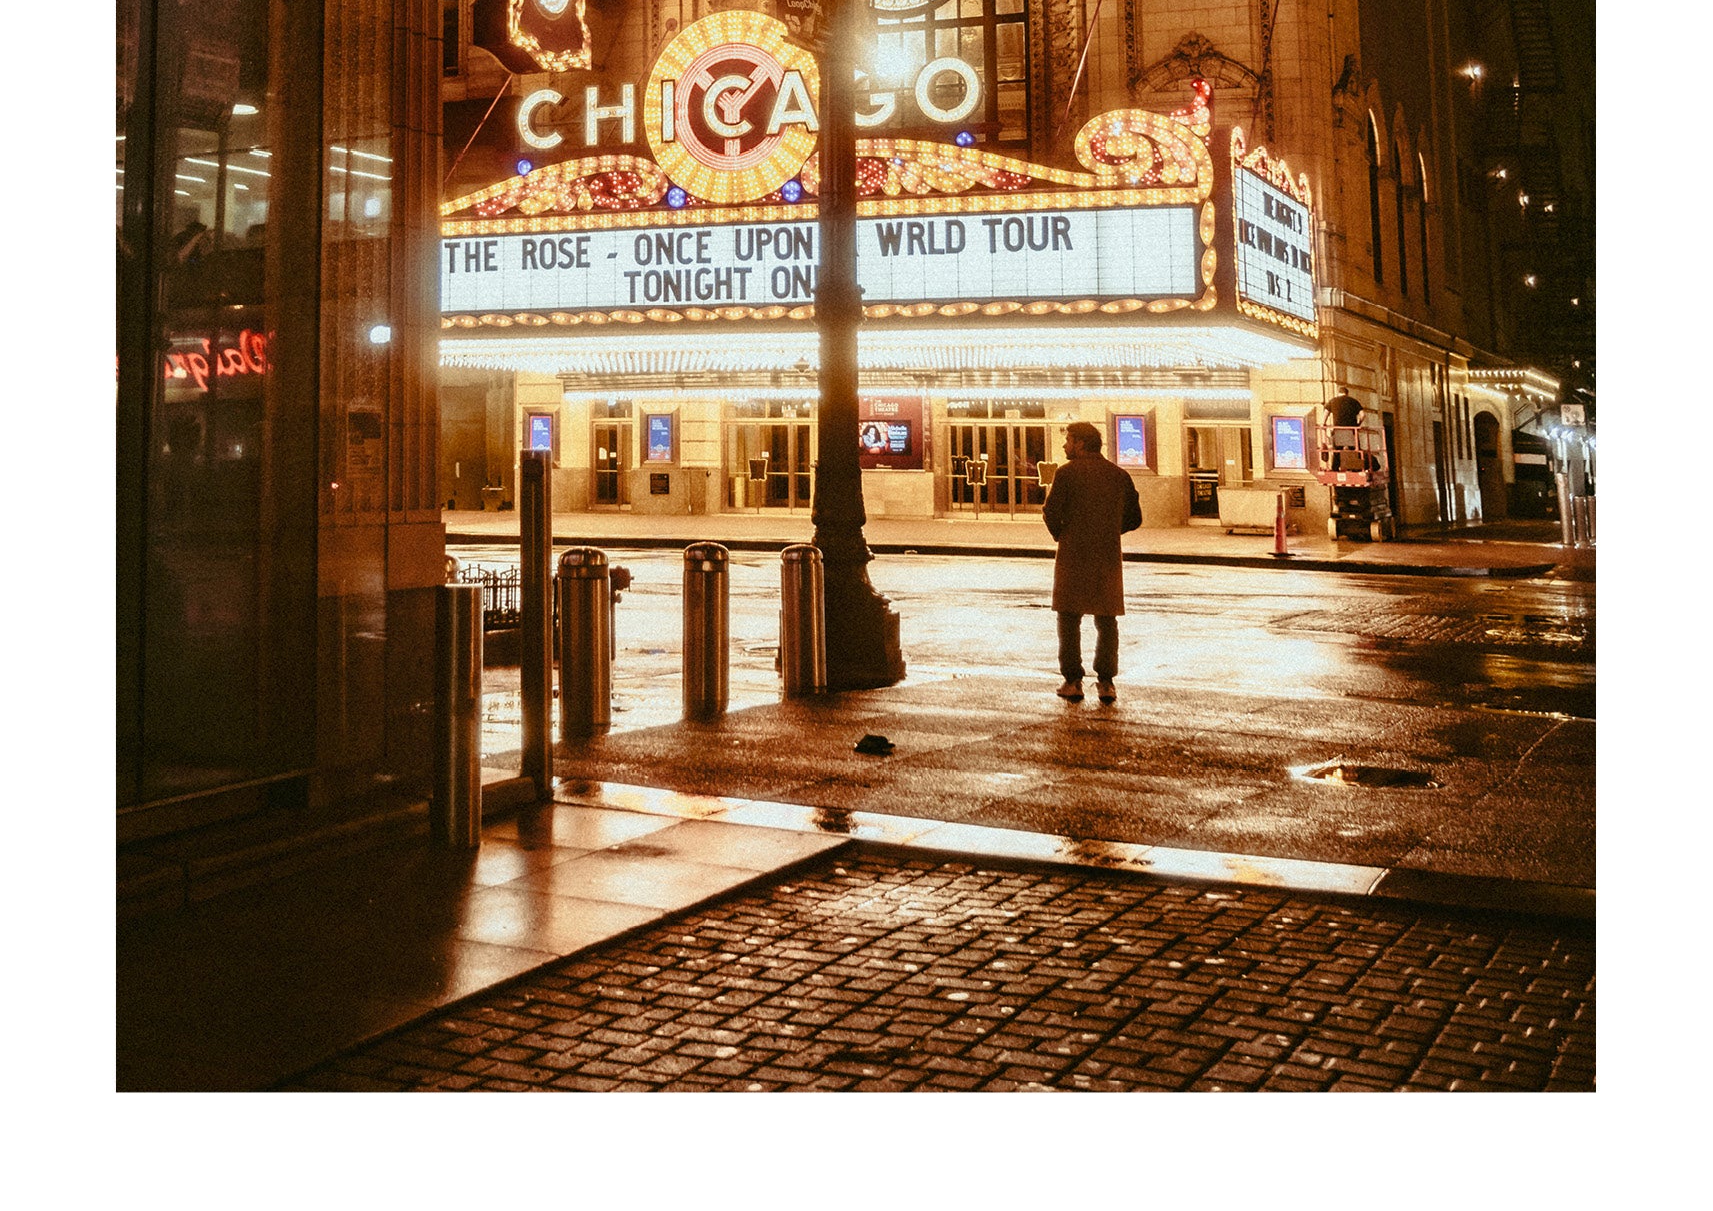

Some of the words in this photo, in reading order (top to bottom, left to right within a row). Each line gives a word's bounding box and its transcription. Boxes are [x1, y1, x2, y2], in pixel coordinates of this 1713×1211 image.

[517, 56, 980, 149] CHICAGO
[444, 239, 498, 274] THE
[521, 236, 591, 270] ROSE
[634, 230, 712, 266] ONCE
[734, 226, 813, 261] UPON
[875, 219, 966, 257] WRLD
[982, 215, 1074, 254] TOUR
[623, 267, 752, 304] TONIGHT
